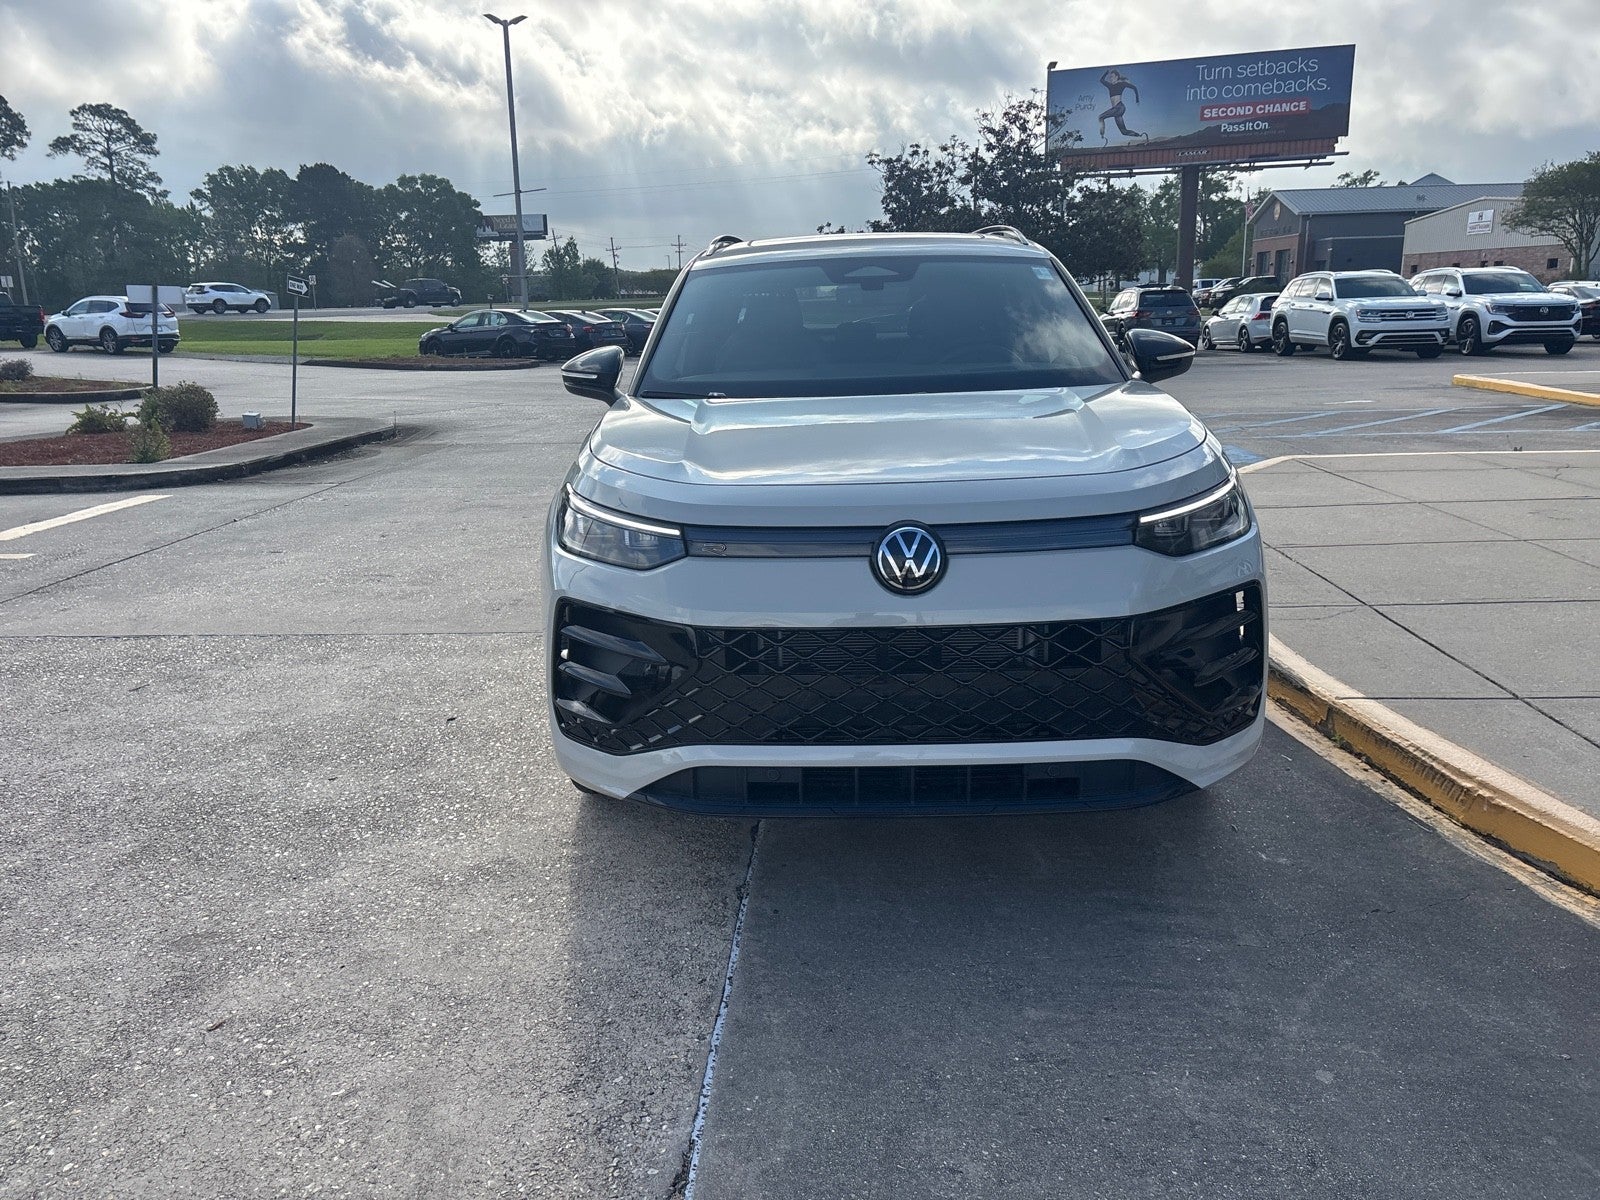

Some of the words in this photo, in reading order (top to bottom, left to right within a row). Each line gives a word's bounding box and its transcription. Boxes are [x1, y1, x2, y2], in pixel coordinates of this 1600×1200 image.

[1196, 64, 1232, 81] Turn
[1237, 57, 1319, 78] setbacks
[1187, 85, 1218, 101] into
[1222, 76, 1331, 98] comebacks.
[1203, 105, 1253, 118] SECOND
[1256, 101, 1307, 114] CHANCE
[878, 527, 941, 589] VW
